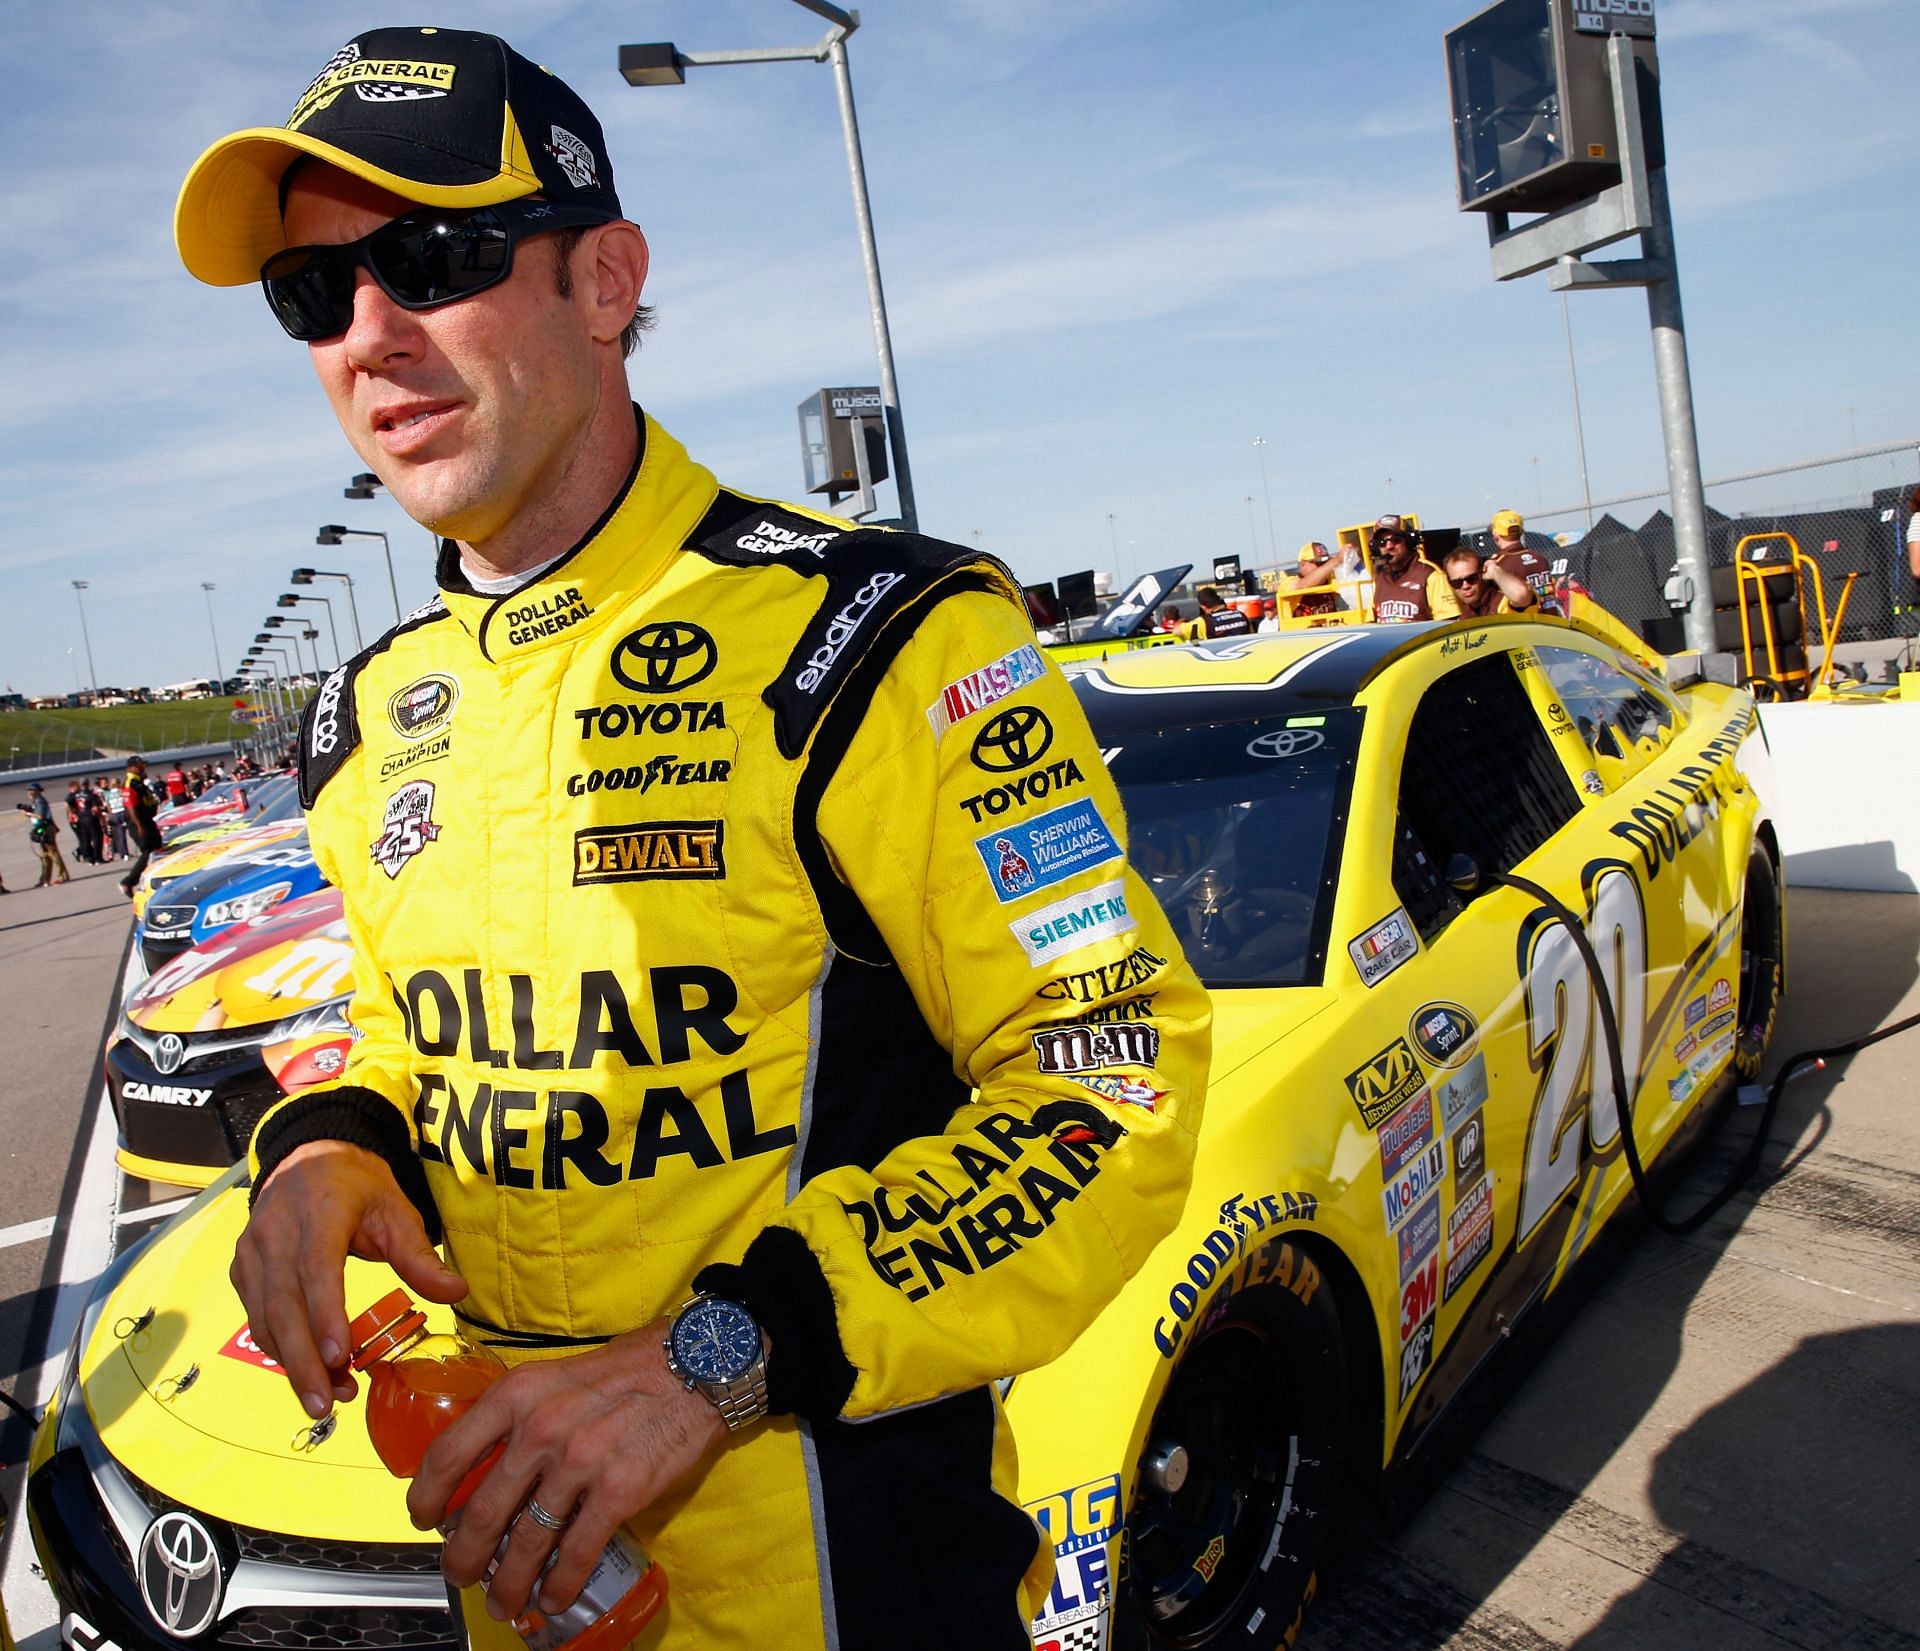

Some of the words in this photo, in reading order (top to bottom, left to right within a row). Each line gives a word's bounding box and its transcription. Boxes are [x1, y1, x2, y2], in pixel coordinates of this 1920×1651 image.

[337, 62, 444, 81] GENERAL
[1551, 558, 1568, 575] 10
[505, 587, 583, 627] DOLLAR
[508, 603, 595, 646] GENERAL
[795, 572, 906, 694] sparco
[957, 644, 1047, 715] NASCAR
[574, 701, 726, 740] TOYOTA
[381, 736, 451, 776] CHAMPION
[567, 755, 731, 797] GOODYEAR
[960, 758, 1085, 824] TOYOTA
[1029, 813, 1092, 848] SHERWIN
[1033, 828, 1100, 865] WILLIAMS
[1035, 946, 1165, 1003] CITIZEN
[1364, 956, 1390, 979] RACE
[1391, 939, 1412, 959] CAR
[384, 964, 750, 1070] OLLAR
[1436, 1025, 1460, 1051] Sprint
[1517, 861, 1646, 1252] 20
[121, 1081, 213, 1107] CAMRY
[1362, 1091, 1404, 1127] MECHANIX
[1401, 1070, 1424, 1097] WEAR
[414, 1068, 798, 1190] ENERAL
[1382, 1095, 1430, 1160] Duralast
[1385, 1156, 1428, 1222] Mobil
[1449, 1180, 1486, 1234] LINCOLN
[1154, 1192, 1319, 1359] GOODYEAR
[1400, 1252, 1438, 1342] 3M
[1202, 1543, 1221, 1574] AERO
